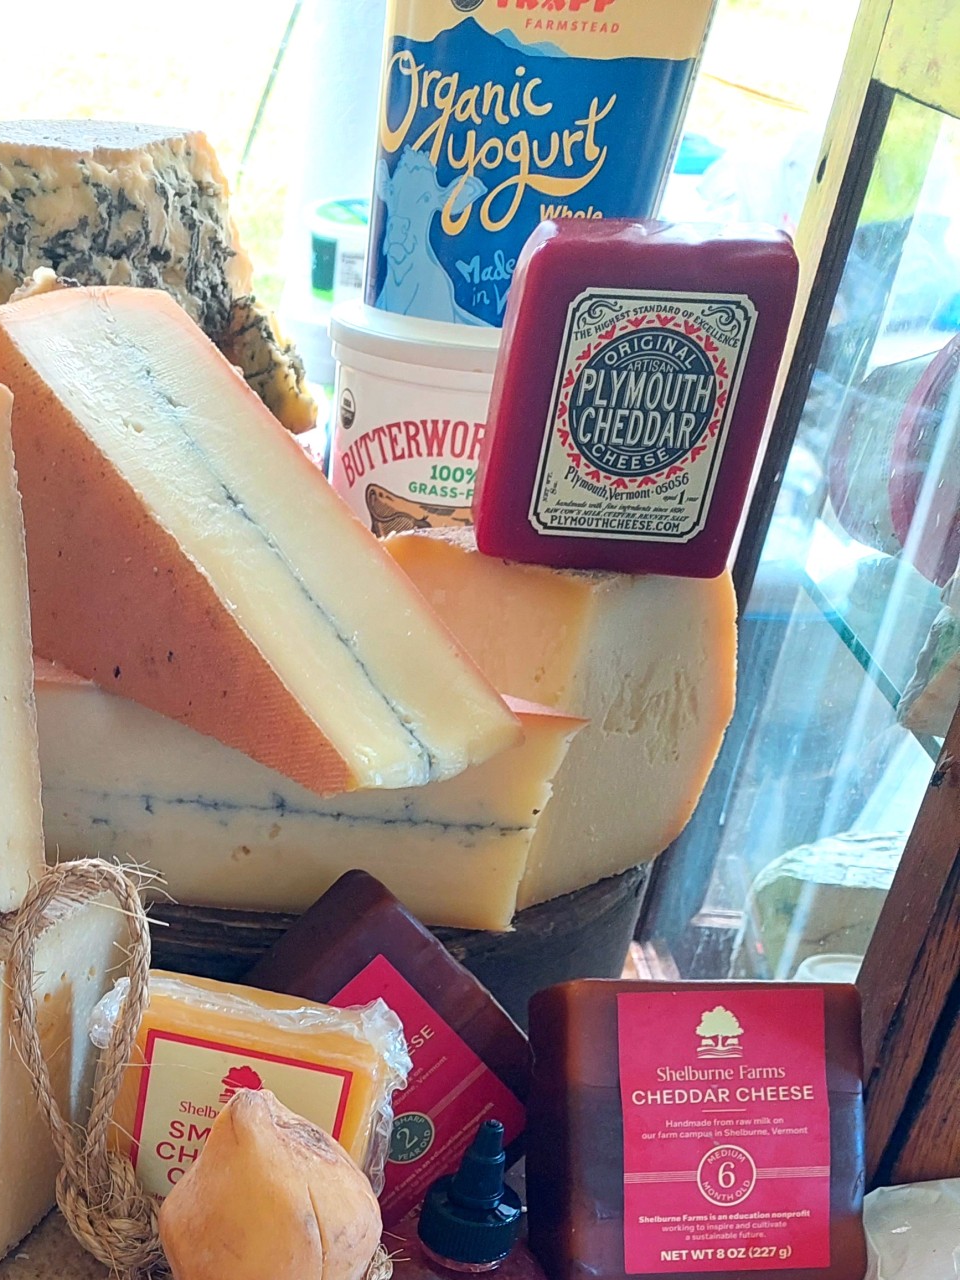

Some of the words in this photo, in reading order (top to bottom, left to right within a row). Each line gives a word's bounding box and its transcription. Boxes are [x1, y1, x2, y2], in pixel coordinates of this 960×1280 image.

[526, 18, 620, 33] FARMSTEAD
[380, 50, 553, 166] Organic
[441, 94, 617, 236] yogurt
[574, 329, 593, 341] THE
[595, 310, 630, 333] HIGHEST
[633, 304, 680, 315] STANDARD
[682, 310, 694, 319] OF
[693, 316, 740, 349] EXCELLENCE
[605, 335, 697, 369] ORIGINAL
[627, 360, 674, 372] ARTISAN
[576, 369, 714, 413] PLYMOUTH
[577, 407, 696, 449] CHEDDAR
[342, 420, 486, 488] BUTTERWOR
[592, 445, 669, 469] CHEESE
[430, 465, 477, 484] 100%
[655, 473, 689, 494] 05056
[550, 516, 680, 532] PLYMOUTHCHEESE.COM
[657, 1066, 734, 1082] Shelburne
[739, 1065, 785, 1080] Farms
[632, 1088, 730, 1105] CHEDDAR
[736, 1085, 814, 1101] CHEESE
[666, 1118, 711, 1128] Handmade
[714, 1119, 733, 1127] from
[754, 1117, 771, 1125] milk
[707, 1150, 746, 1165] MEDIUM
[717, 1162, 736, 1188] 6
[703, 1181, 734, 1201] MONTH
[735, 1180, 751, 1198] OLD
[660, 1250, 689, 1261] NET
[691, 1249, 715, 1260] WT
[716, 1249, 724, 1259] 8
[727, 1248, 746, 1259] OZ
[749, 1246, 776, 1259] (227
[779, 1246, 792, 1259] g)
